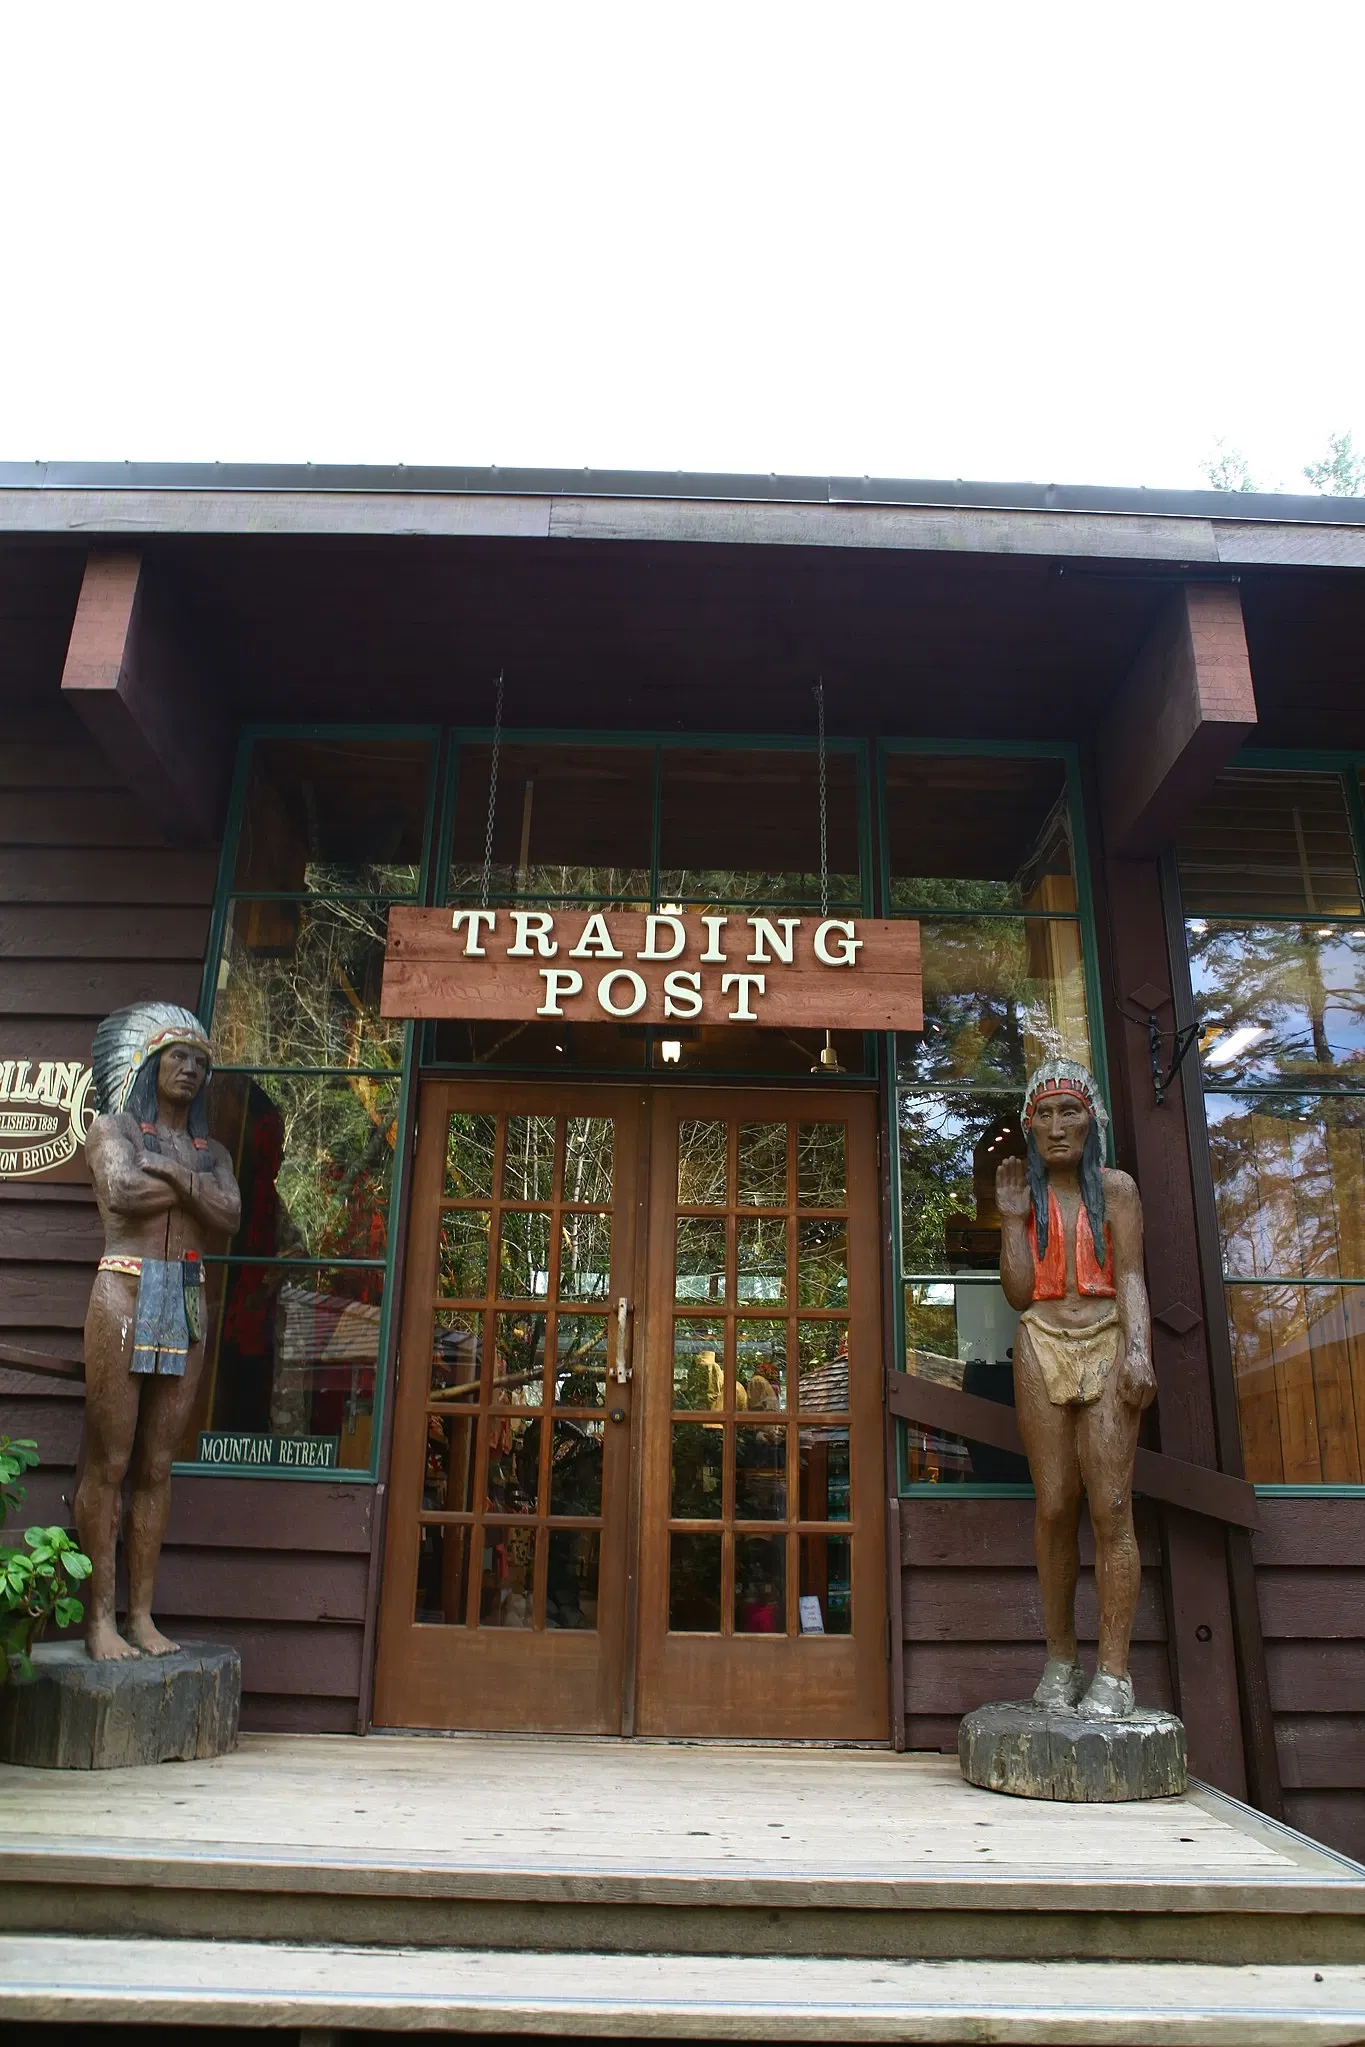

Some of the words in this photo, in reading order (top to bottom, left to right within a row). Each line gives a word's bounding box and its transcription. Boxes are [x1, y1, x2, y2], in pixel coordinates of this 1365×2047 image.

[452, 910, 864, 967] TRADING
[536, 968, 765, 1021] POST
[0, 1060, 94, 1144] ILAN
[0, 1115, 37, 1130] LISHED
[38, 1116, 59, 1131] 1889
[0, 1151, 18, 1171] ON
[22, 1136, 73, 1169] BRIDGE
[200, 1438, 273, 1463] MOUNTAIN
[278, 1440, 333, 1466] RETREAT
